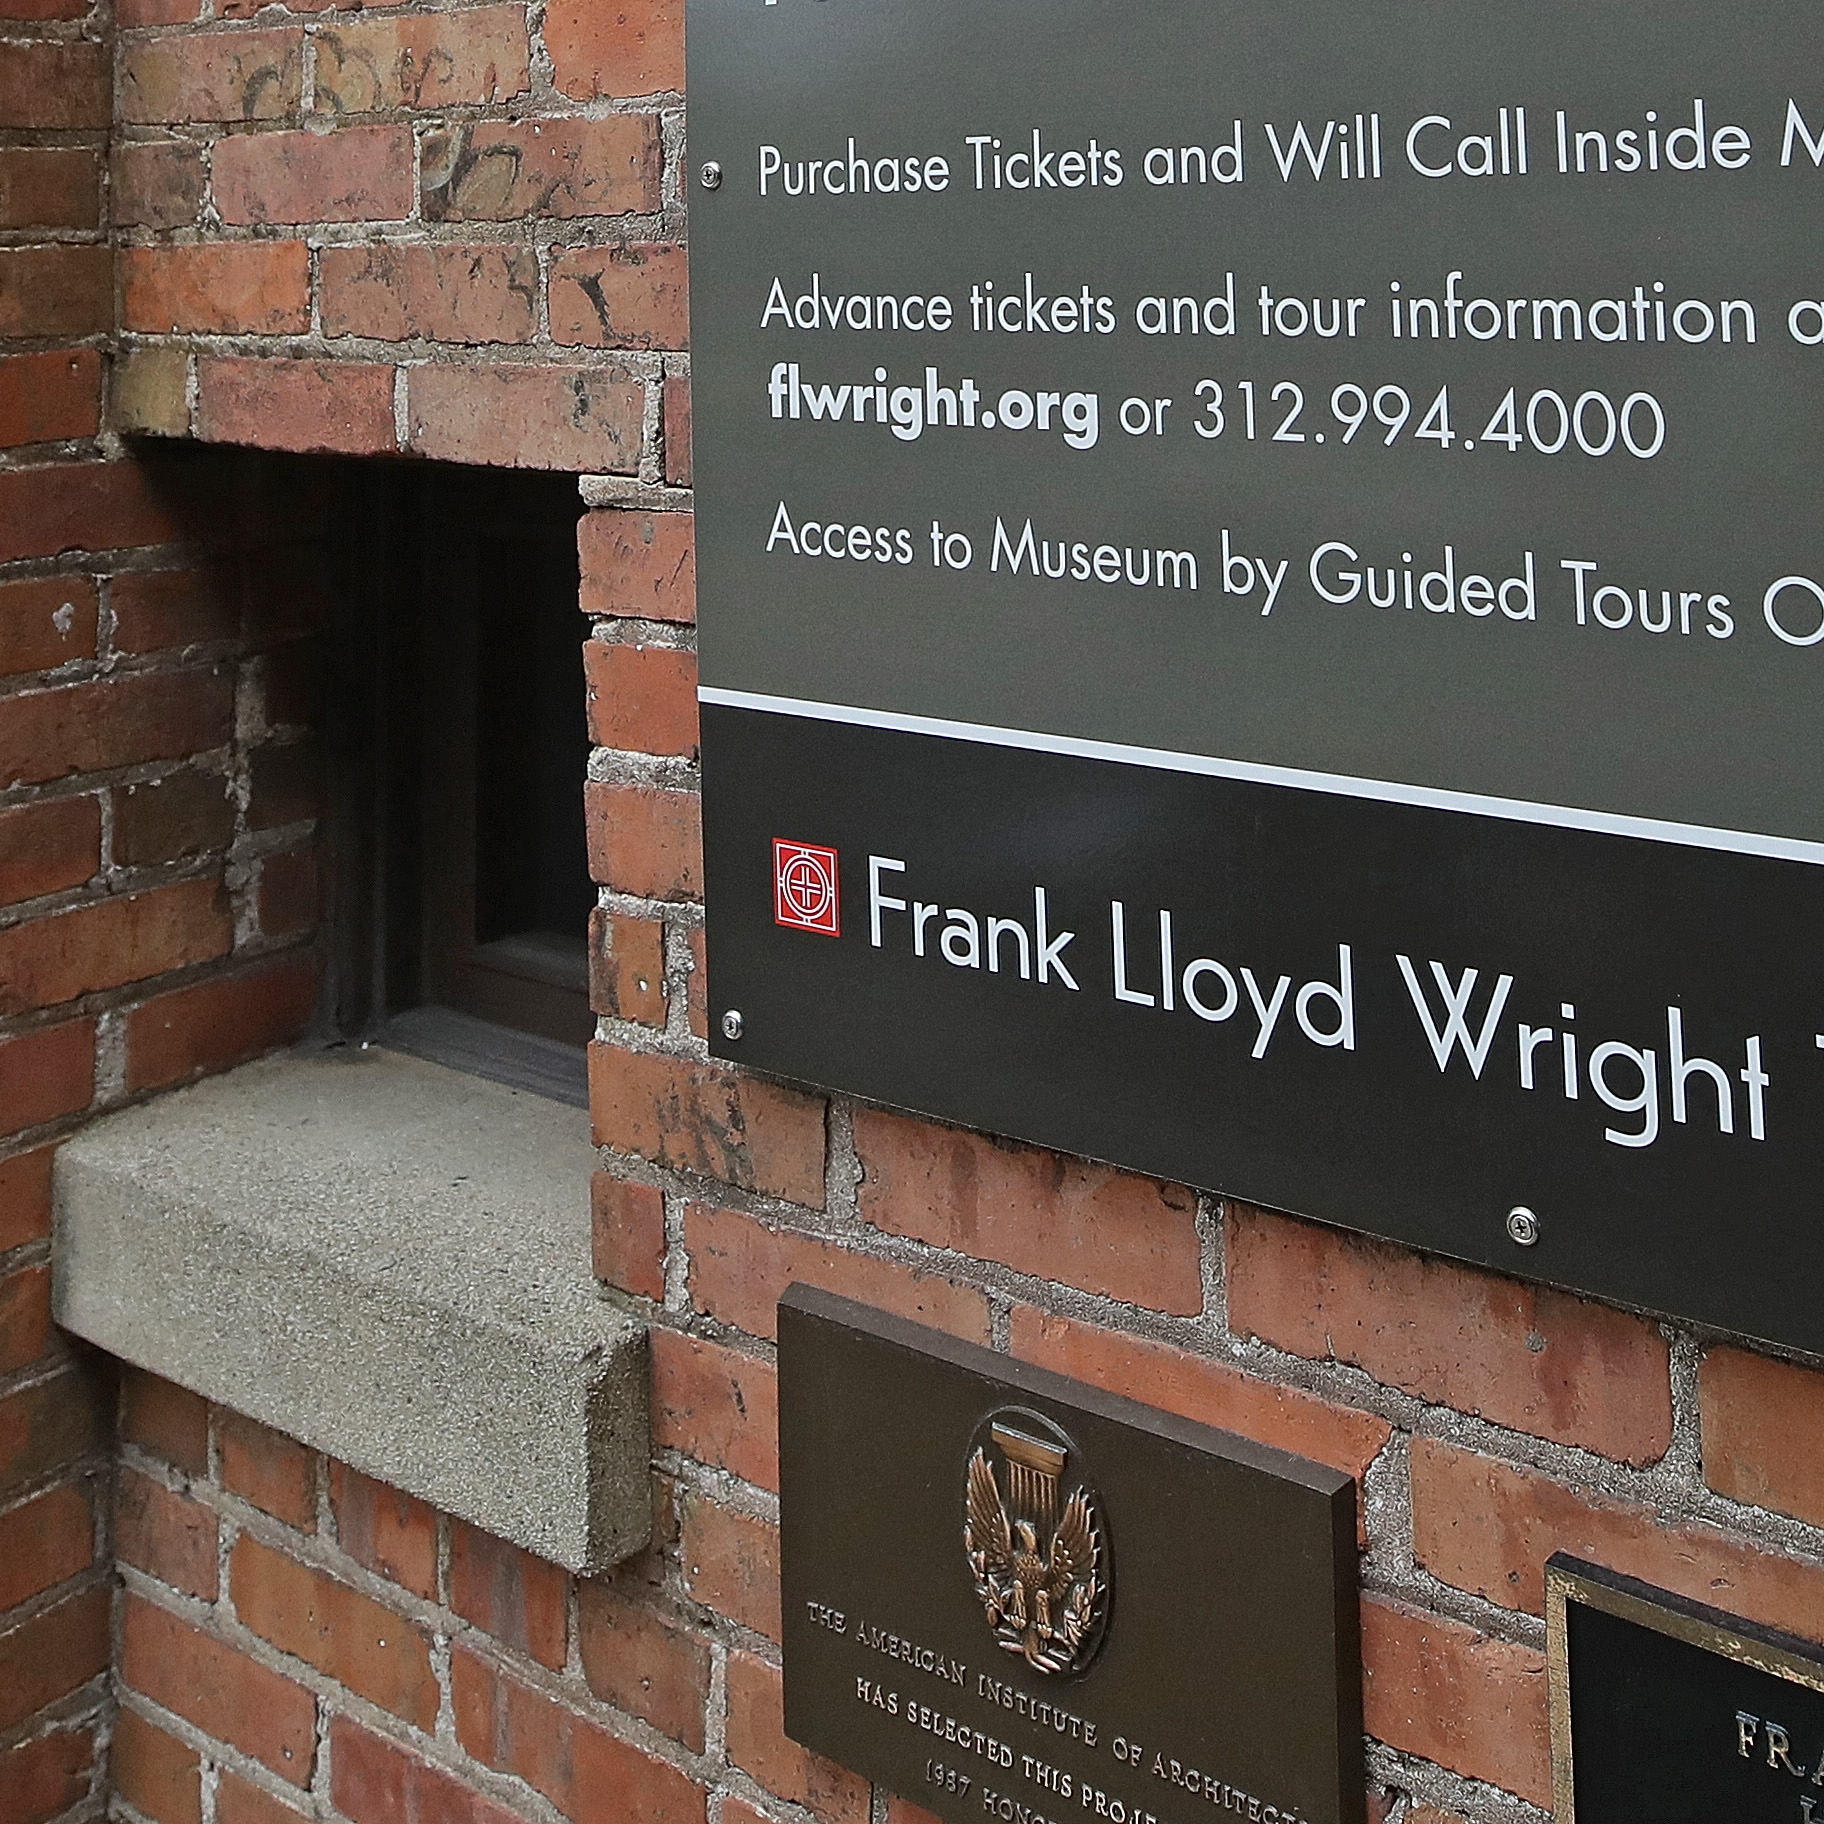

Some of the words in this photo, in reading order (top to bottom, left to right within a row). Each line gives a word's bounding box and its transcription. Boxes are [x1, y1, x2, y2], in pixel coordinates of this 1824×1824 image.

[758, 136, 950, 196] Purchase
[964, 127, 1124, 190] Tickets
[1142, 118, 1243, 185] and
[1263, 112, 1381, 183] Will
[1405, 105, 1527, 178] Call
[1555, 97, 1751, 173] Inside
[759, 271, 953, 331] Advance
[968, 271, 1116, 334] tickets
[1135, 271, 1236, 336] and
[1257, 284, 1367, 337] tour
[1390, 269, 1756, 343] information
[766, 361, 1099, 450] flwright.org
[1118, 396, 1173, 436] or
[1192, 378, 1665, 459] 312.994.4000
[764, 499, 913, 564] Access
[929, 519, 972, 570] to
[989, 514, 1198, 590] Museum
[1220, 528, 1289, 616] by
[1308, 540, 1536, 621] Guided
[1559, 558, 1734, 639] Tours
[867, 853, 1080, 991] Frank
[1110, 899, 1355, 1059] Lloyd
[1394, 952, 1770, 1148] Wright
[806, 1600, 847, 1635] THE
[855, 1621, 967, 1687] AMERICAN
[977, 1674, 1098, 1747] INSTITUTE
[1112, 1736, 1143, 1767] OF
[1151, 1751, 1308, 1824] ARCHITECT
[856, 1677, 900, 1716] HAS
[907, 1700, 1014, 1769] SELECTED
[1022, 1754, 1073, 1798] THIS
[926, 1758, 971, 1798] 1987
